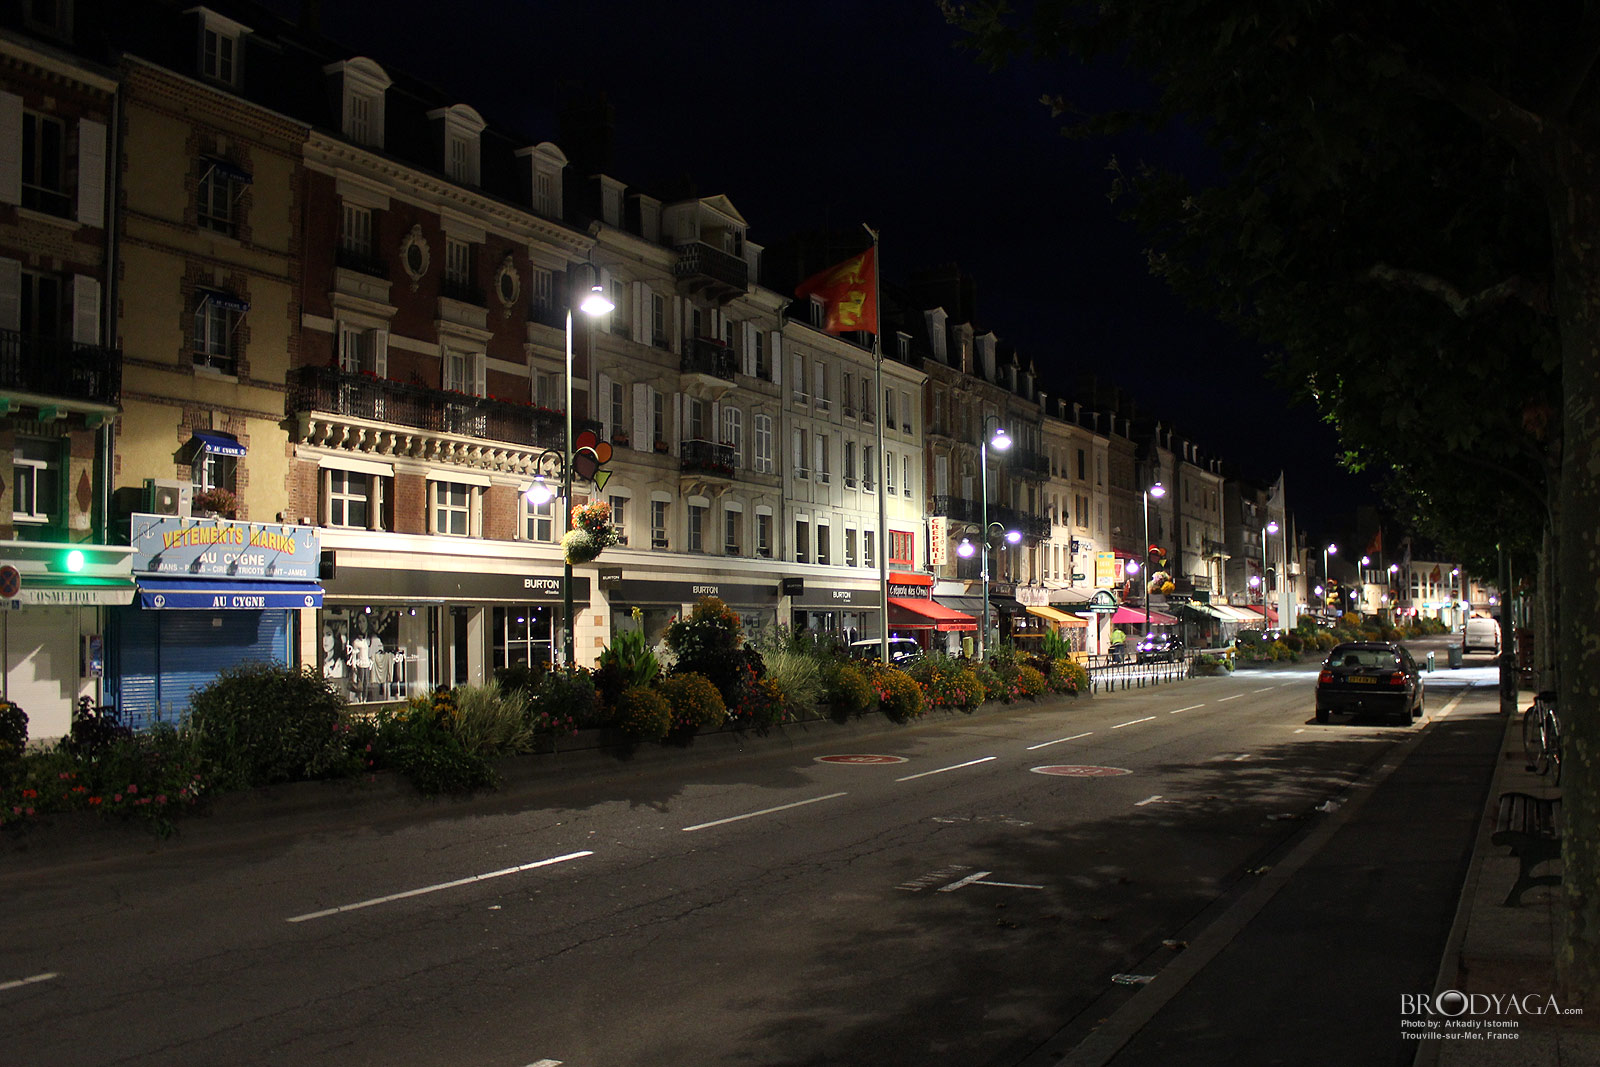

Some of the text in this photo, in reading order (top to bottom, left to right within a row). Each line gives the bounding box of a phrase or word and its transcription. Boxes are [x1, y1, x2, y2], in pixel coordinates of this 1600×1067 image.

[249, 530, 296, 556] MARINS
[199, 552, 265, 566] AU CYGNE
[238, 566, 264, 575] TRICOTS
[524, 579, 560, 589] BURTON
[692, 585, 719, 594] BURTON
[832, 591, 851, 599] BURTON
[213, 596, 265, 607] AU CYGNE
